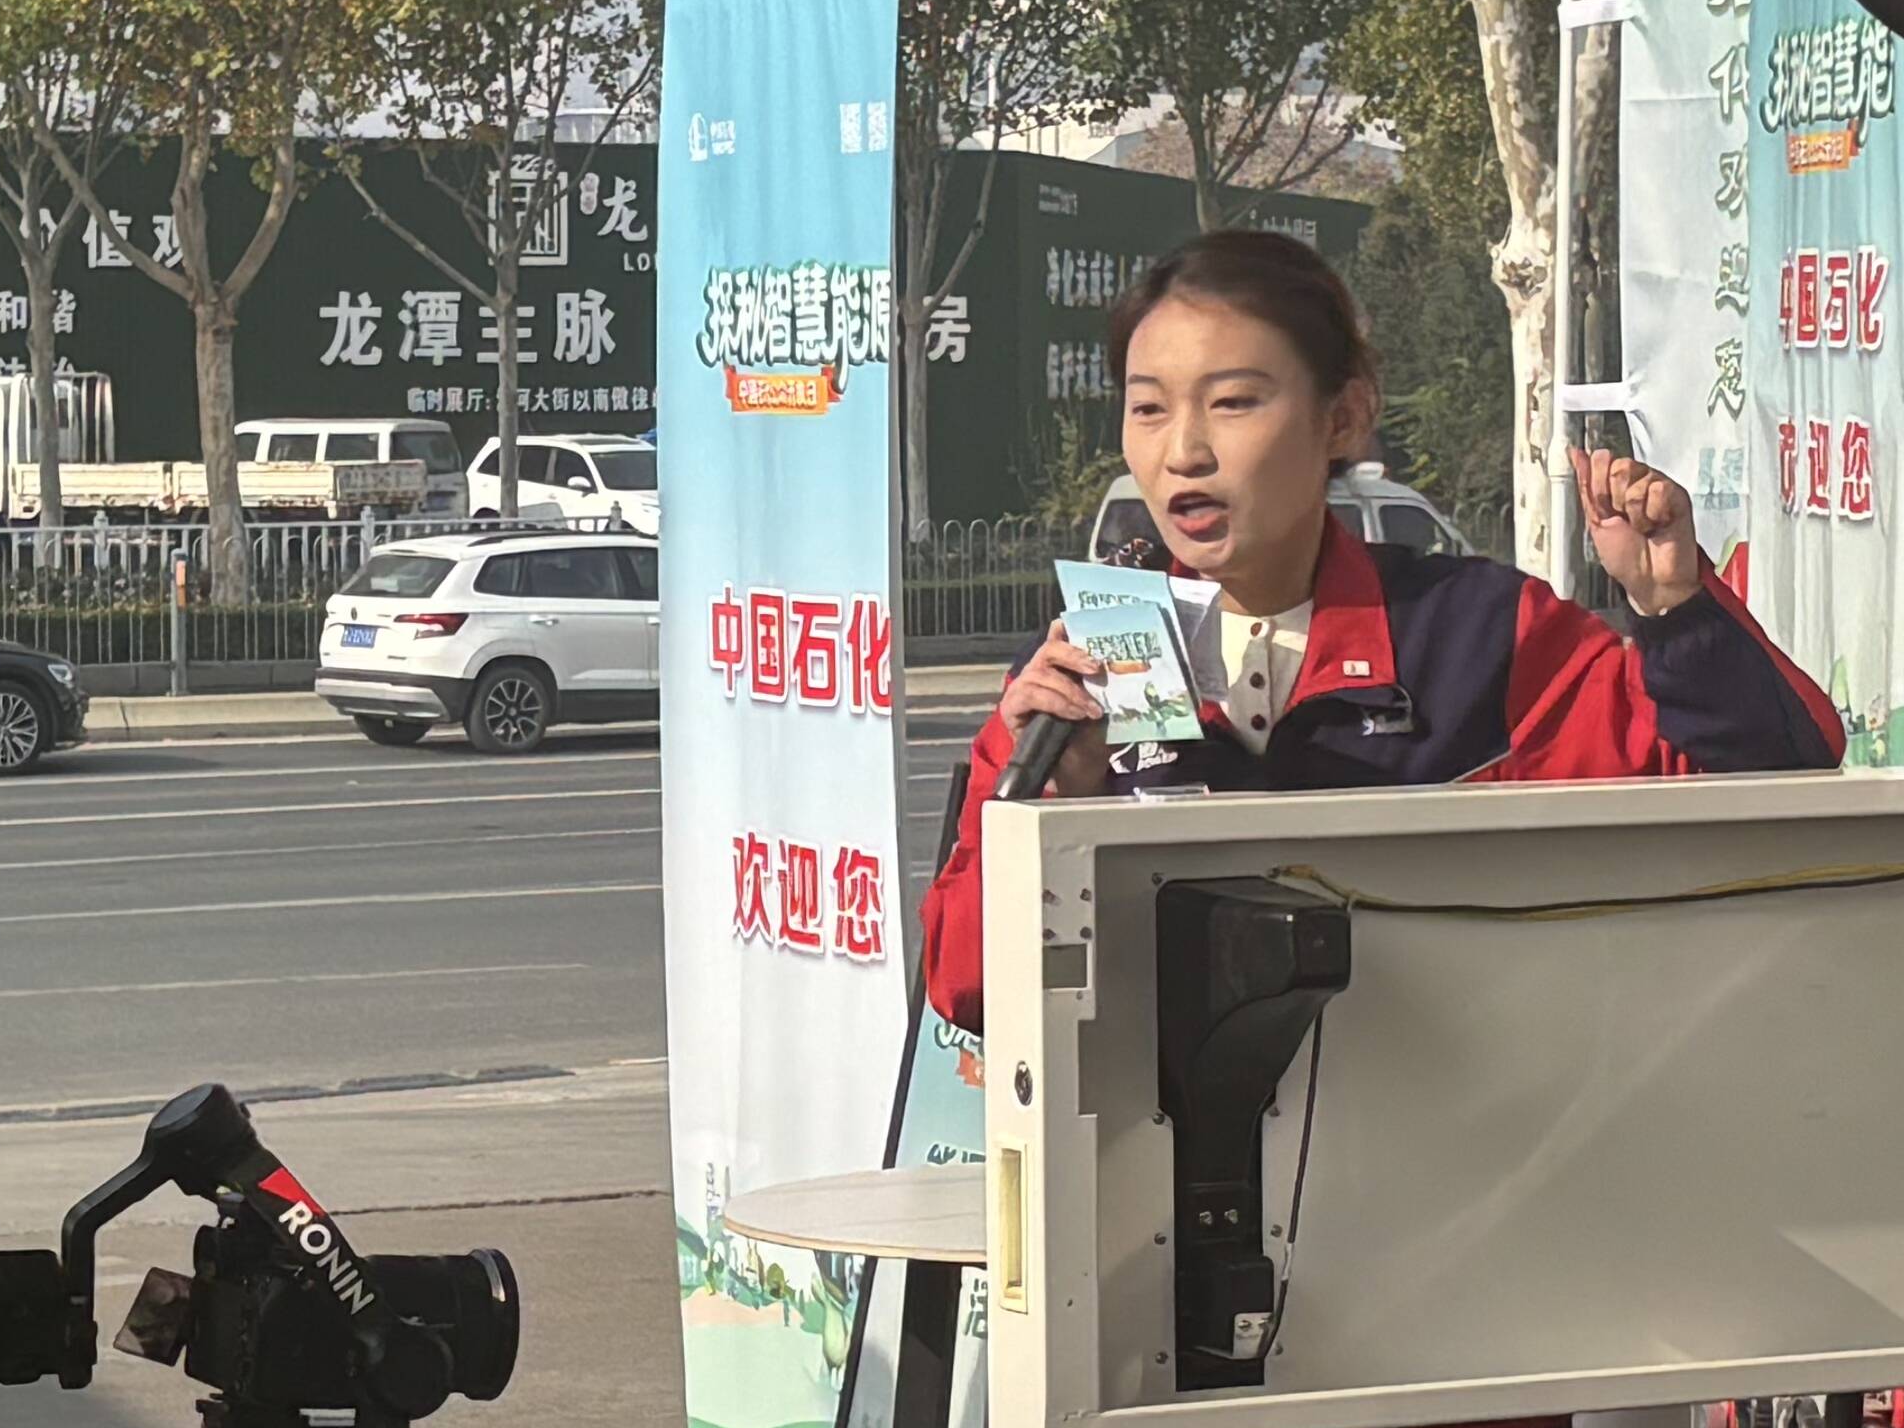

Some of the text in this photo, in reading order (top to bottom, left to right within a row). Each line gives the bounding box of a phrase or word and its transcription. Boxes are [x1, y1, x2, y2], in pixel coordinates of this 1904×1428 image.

[1780, 247, 1889, 350] 中国石化
[710, 585, 892, 712] 中国石化
[731, 832, 886, 958] 欢迎您
[279, 1201, 375, 1317] RONIN
